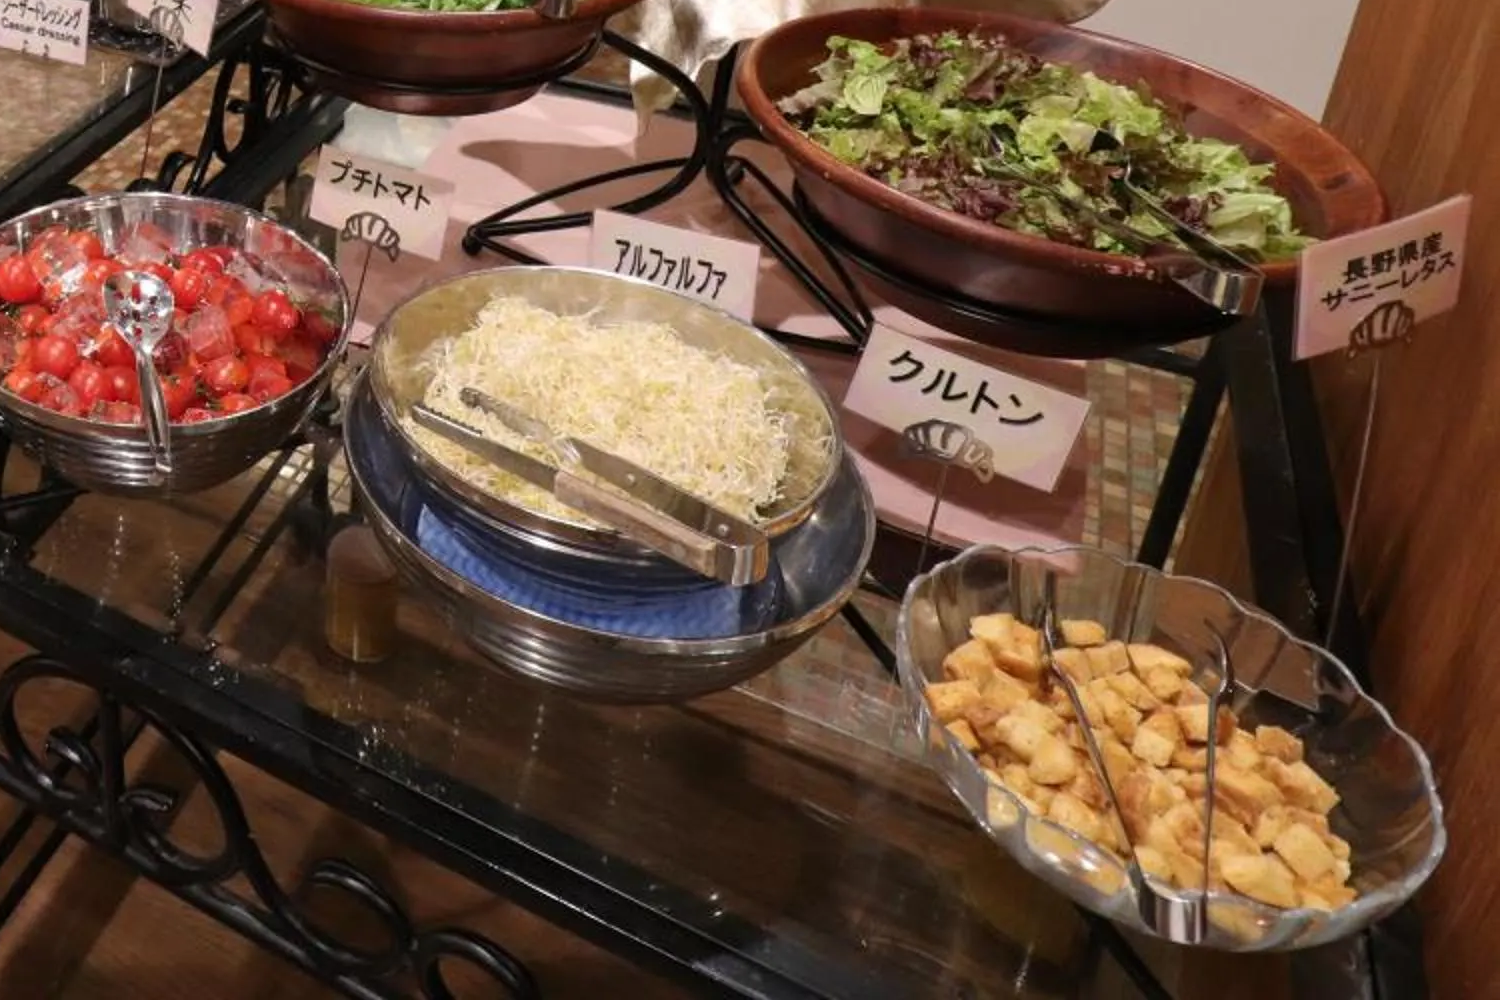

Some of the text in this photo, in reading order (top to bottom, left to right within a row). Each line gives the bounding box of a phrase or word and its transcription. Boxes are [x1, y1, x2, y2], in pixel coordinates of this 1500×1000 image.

[329, 159, 431, 211] プチトマト
[614, 238, 728, 300] アルファルファ
[1320, 250, 1457, 313] サニーレタス
[1341, 231, 1443, 285] 長野県産
[888, 350, 1045, 426] クルトン
